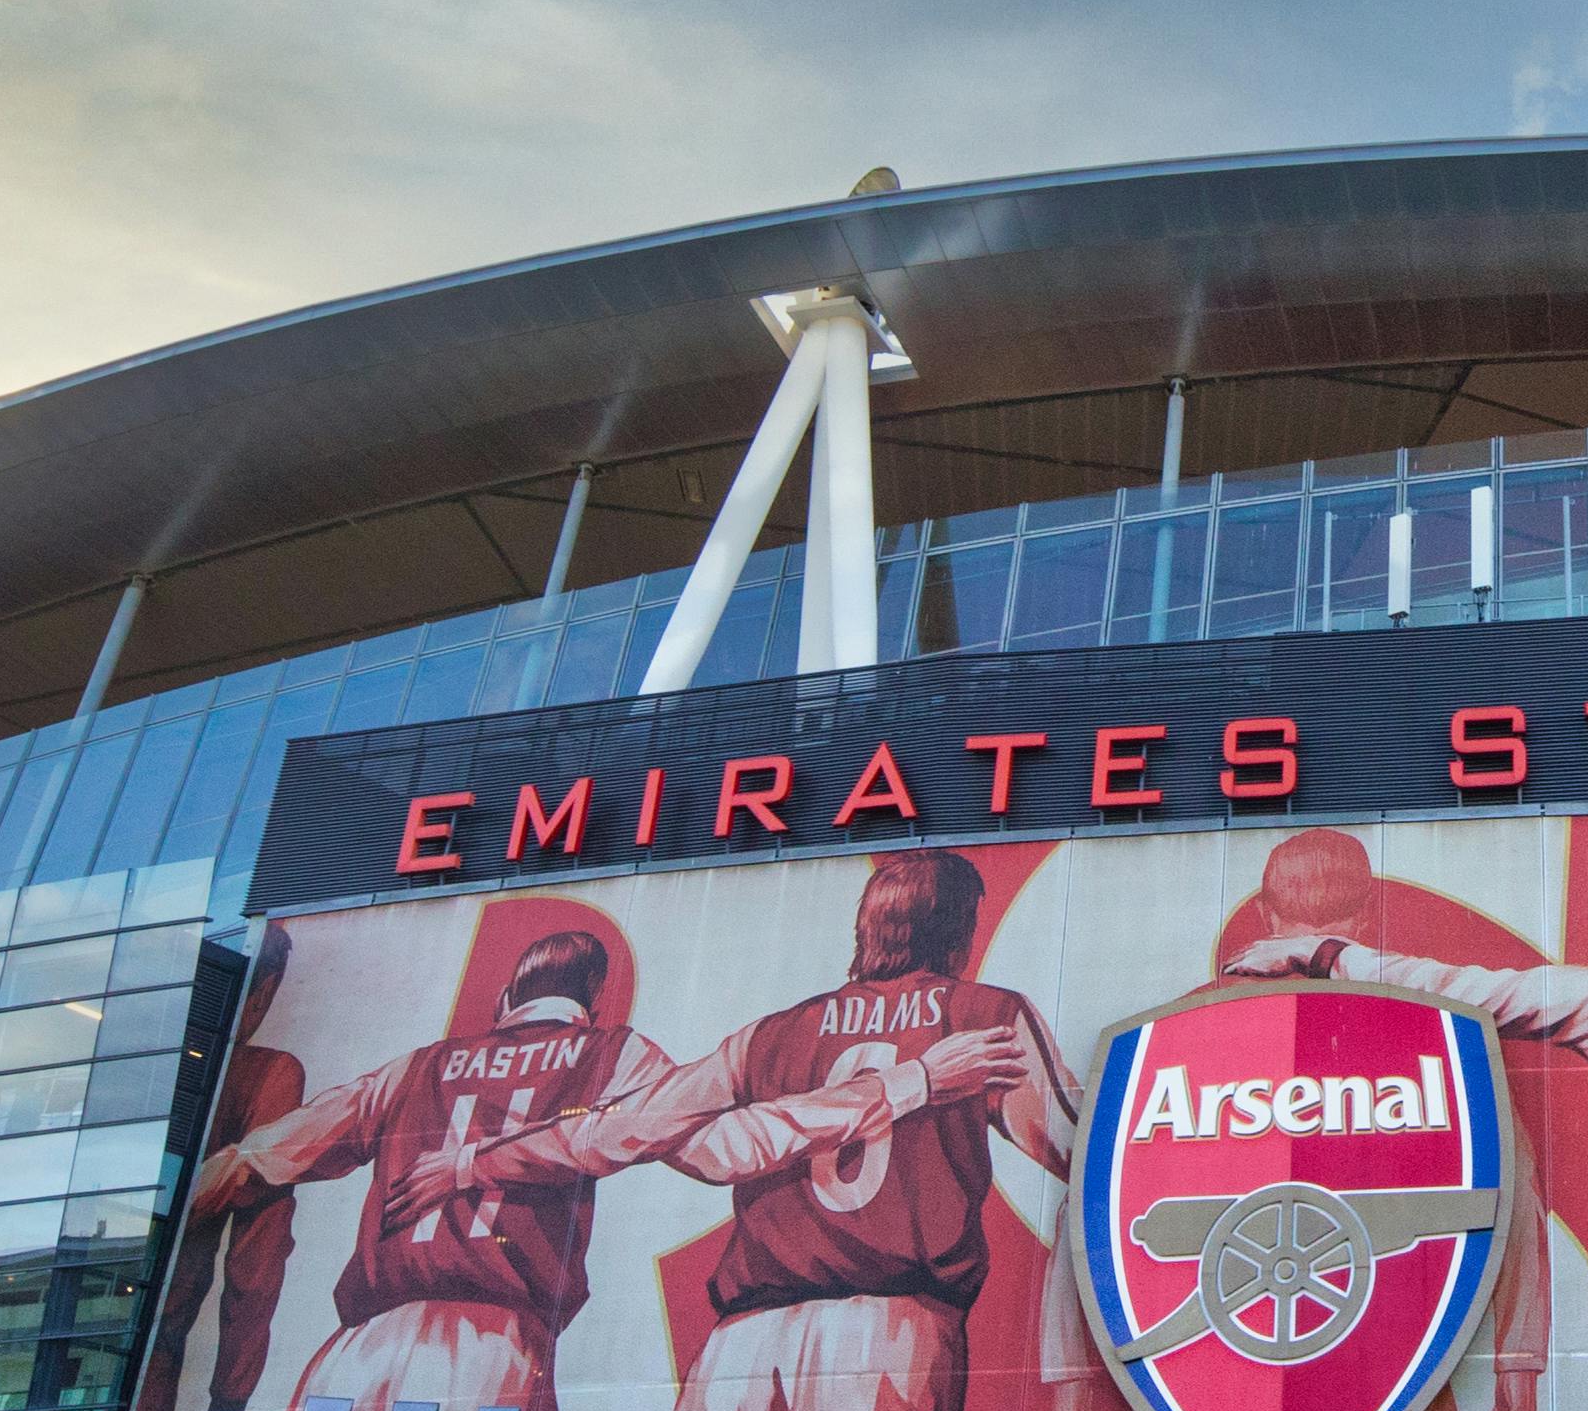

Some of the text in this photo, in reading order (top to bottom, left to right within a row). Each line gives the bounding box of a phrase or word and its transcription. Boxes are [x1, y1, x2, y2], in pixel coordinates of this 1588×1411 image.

[396, 716, 1298, 874] EMIRATES
[818, 985, 946, 1038] ADAMS
[443, 1035, 587, 1083] BASTIN
[1130, 1055, 1451, 1144] Arsenal
